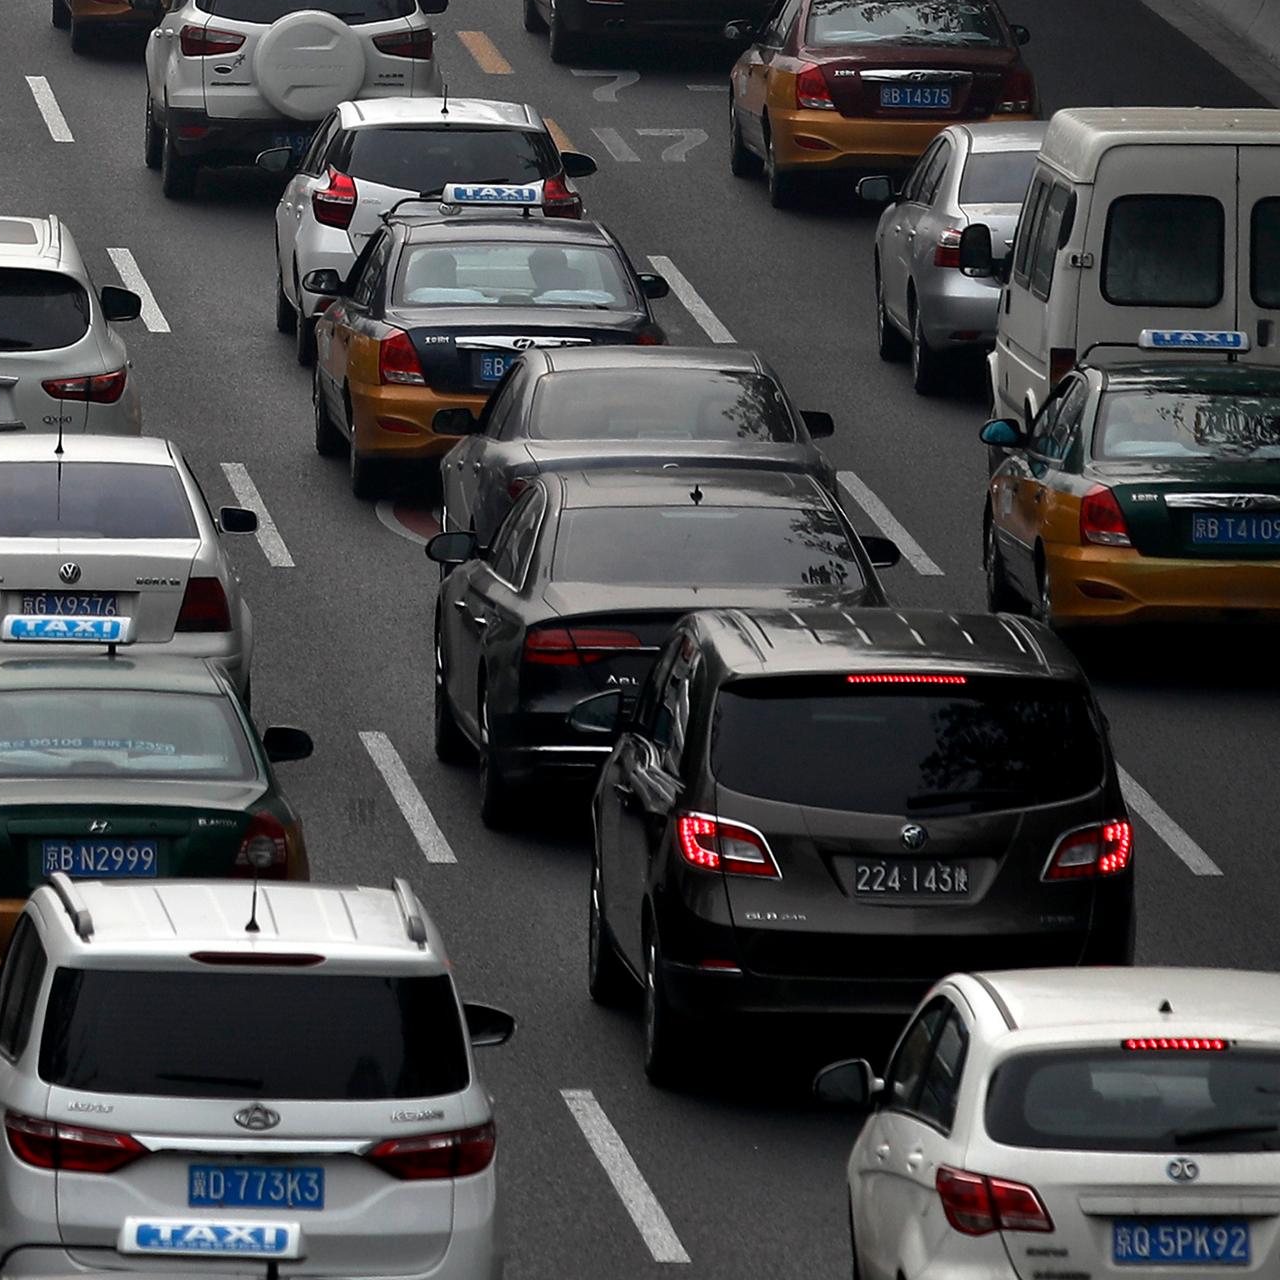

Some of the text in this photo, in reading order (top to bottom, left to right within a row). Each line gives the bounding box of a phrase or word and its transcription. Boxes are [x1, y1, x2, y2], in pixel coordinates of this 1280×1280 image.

[590, 127, 709, 162] 17
[464, 187, 529, 196] TAXI
[1163, 332, 1234, 341] TAXI
[21, 620, 112, 632] TAXI
[45, 846, 154, 872] 京B·N2999
[856, 865, 969, 892] 224·143使
[192, 1168, 321, 1208] 冀D·773K3
[149, 1225, 281, 1244] TAXI
[1115, 1228, 1247, 1260] 京Q·5PK92
